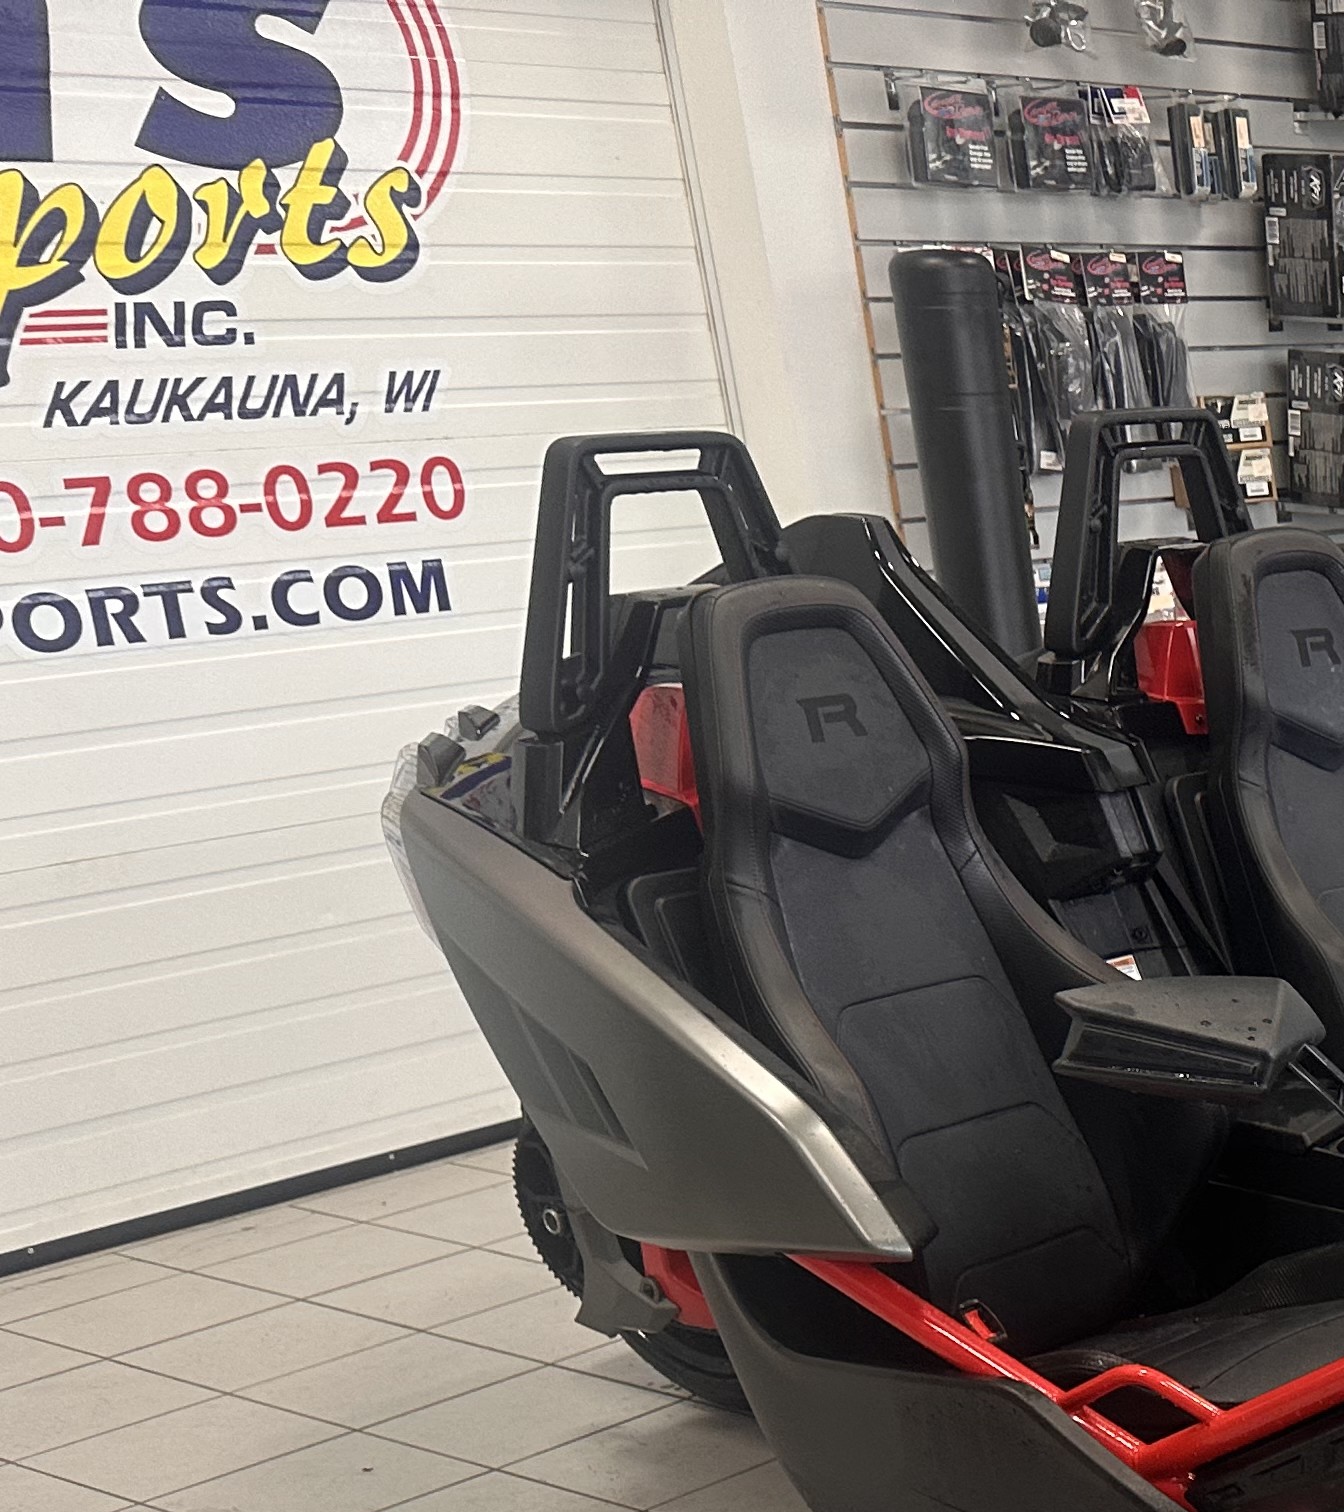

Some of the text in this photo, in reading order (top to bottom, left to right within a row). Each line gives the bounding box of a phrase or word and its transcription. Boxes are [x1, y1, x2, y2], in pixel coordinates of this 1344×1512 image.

[114, 300, 256, 350] INC.
[42, 369, 442, 429] KAUKAUNA, WI
[0, 558, 452, 653] ORTS.COM
[1289, 627, 1343, 669] R
[795, 692, 869, 744] R
